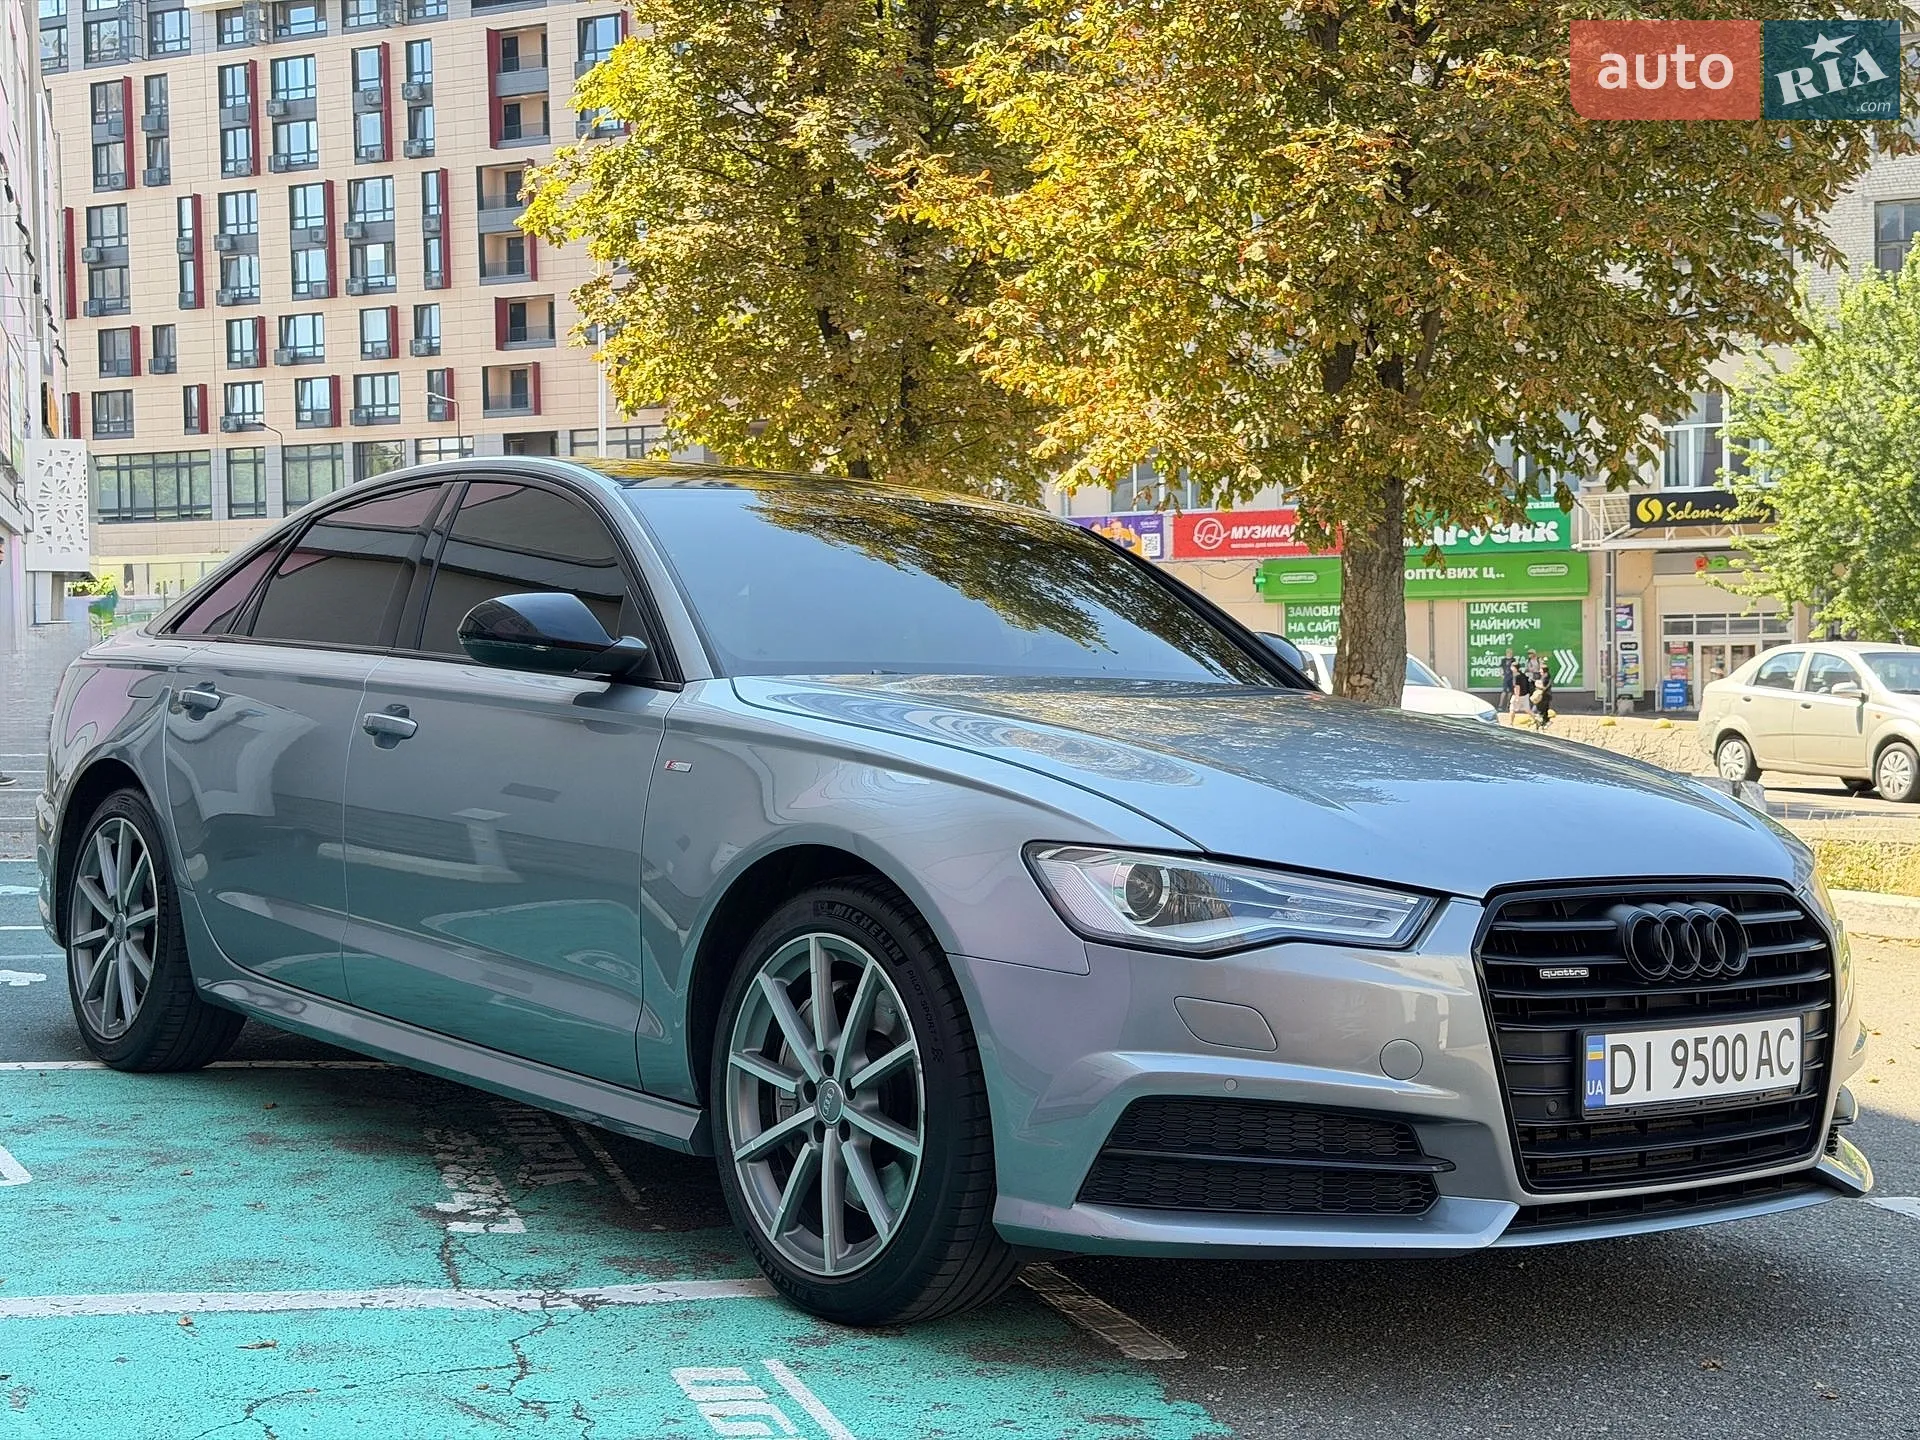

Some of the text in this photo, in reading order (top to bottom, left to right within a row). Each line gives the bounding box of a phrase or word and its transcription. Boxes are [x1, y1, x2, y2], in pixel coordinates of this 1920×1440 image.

[1470, 602, 1529, 614] ШУКАЄТЕ
[1287, 619, 1339, 633] НА САЙТ
[1470, 617, 1541, 630] НАЙНИЖЧІ
[831, 902, 904, 962] MICHELIN
[1542, 969, 1588, 979] quattro
[1609, 1028, 1795, 1096] DI 9500 AC
[1587, 1079, 1604, 1097] UA
